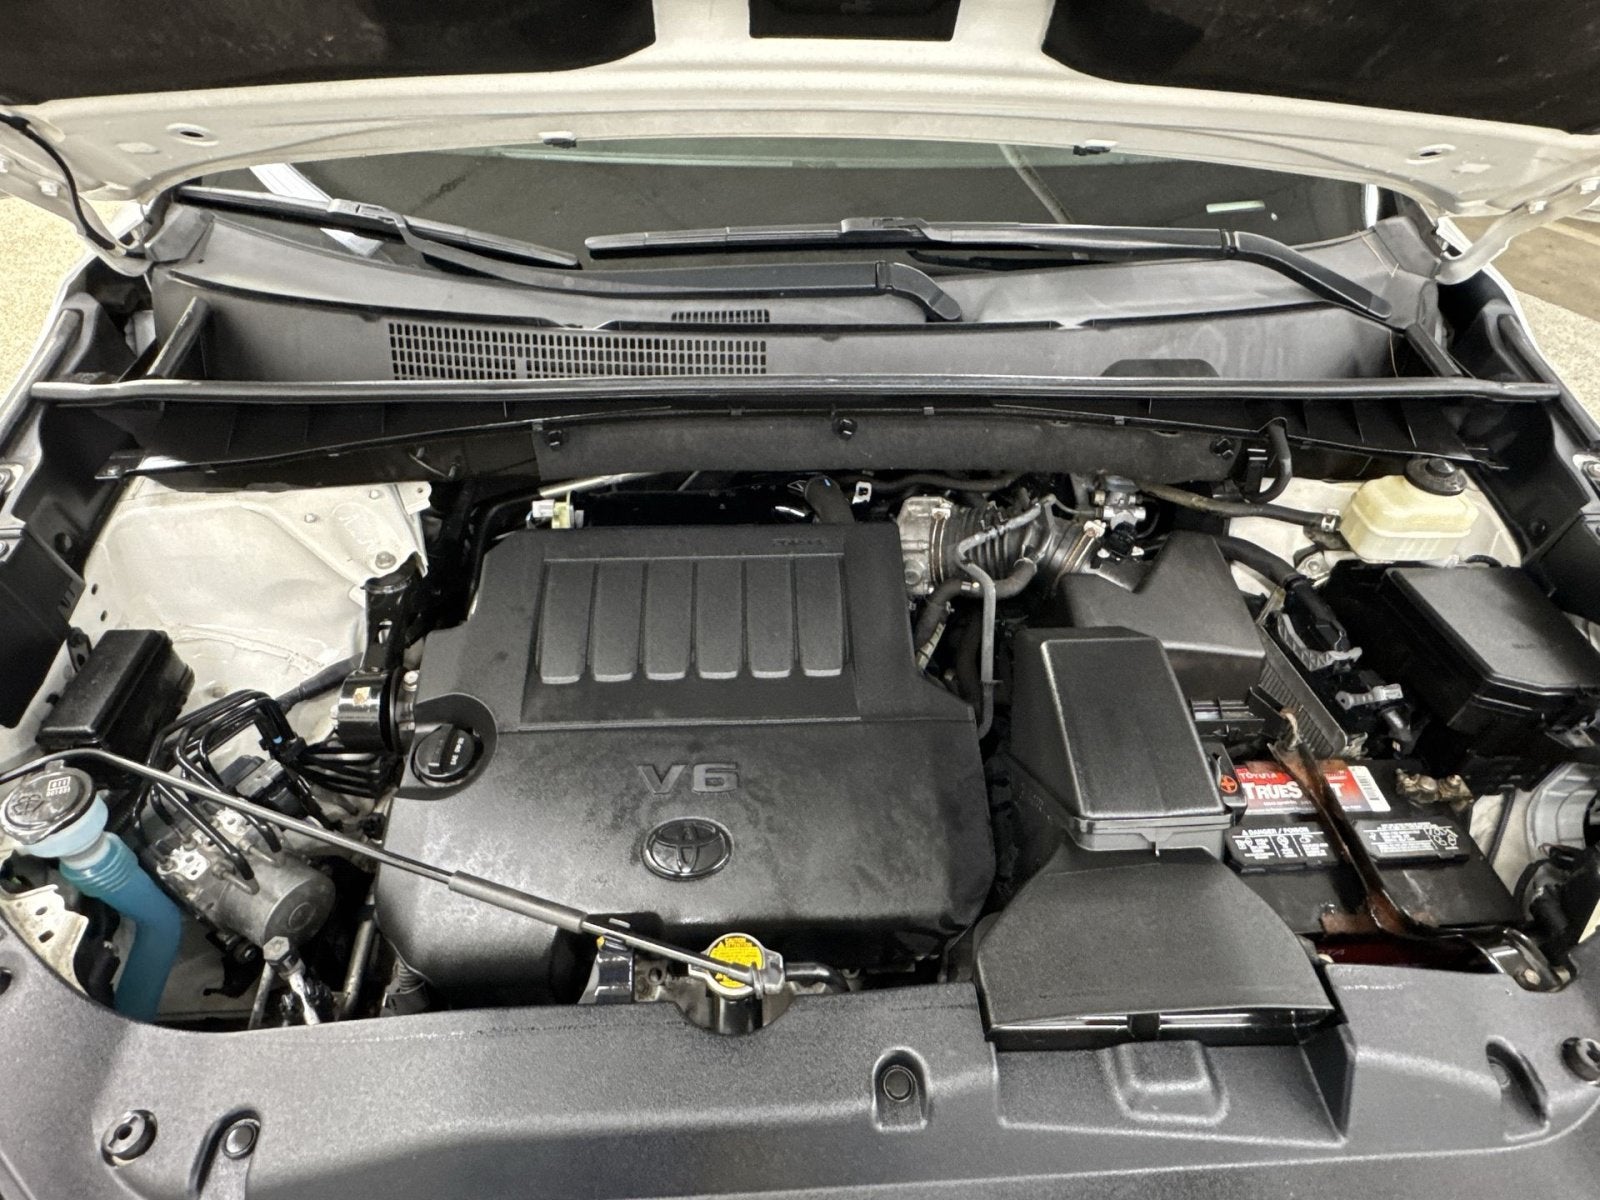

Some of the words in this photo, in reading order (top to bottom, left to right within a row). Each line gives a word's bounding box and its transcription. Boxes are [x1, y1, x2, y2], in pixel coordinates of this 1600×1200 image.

[636, 763, 739, 794] V6
[1239, 772, 1278, 780] TOYOTA
[1248, 828, 1277, 836] DANGER
